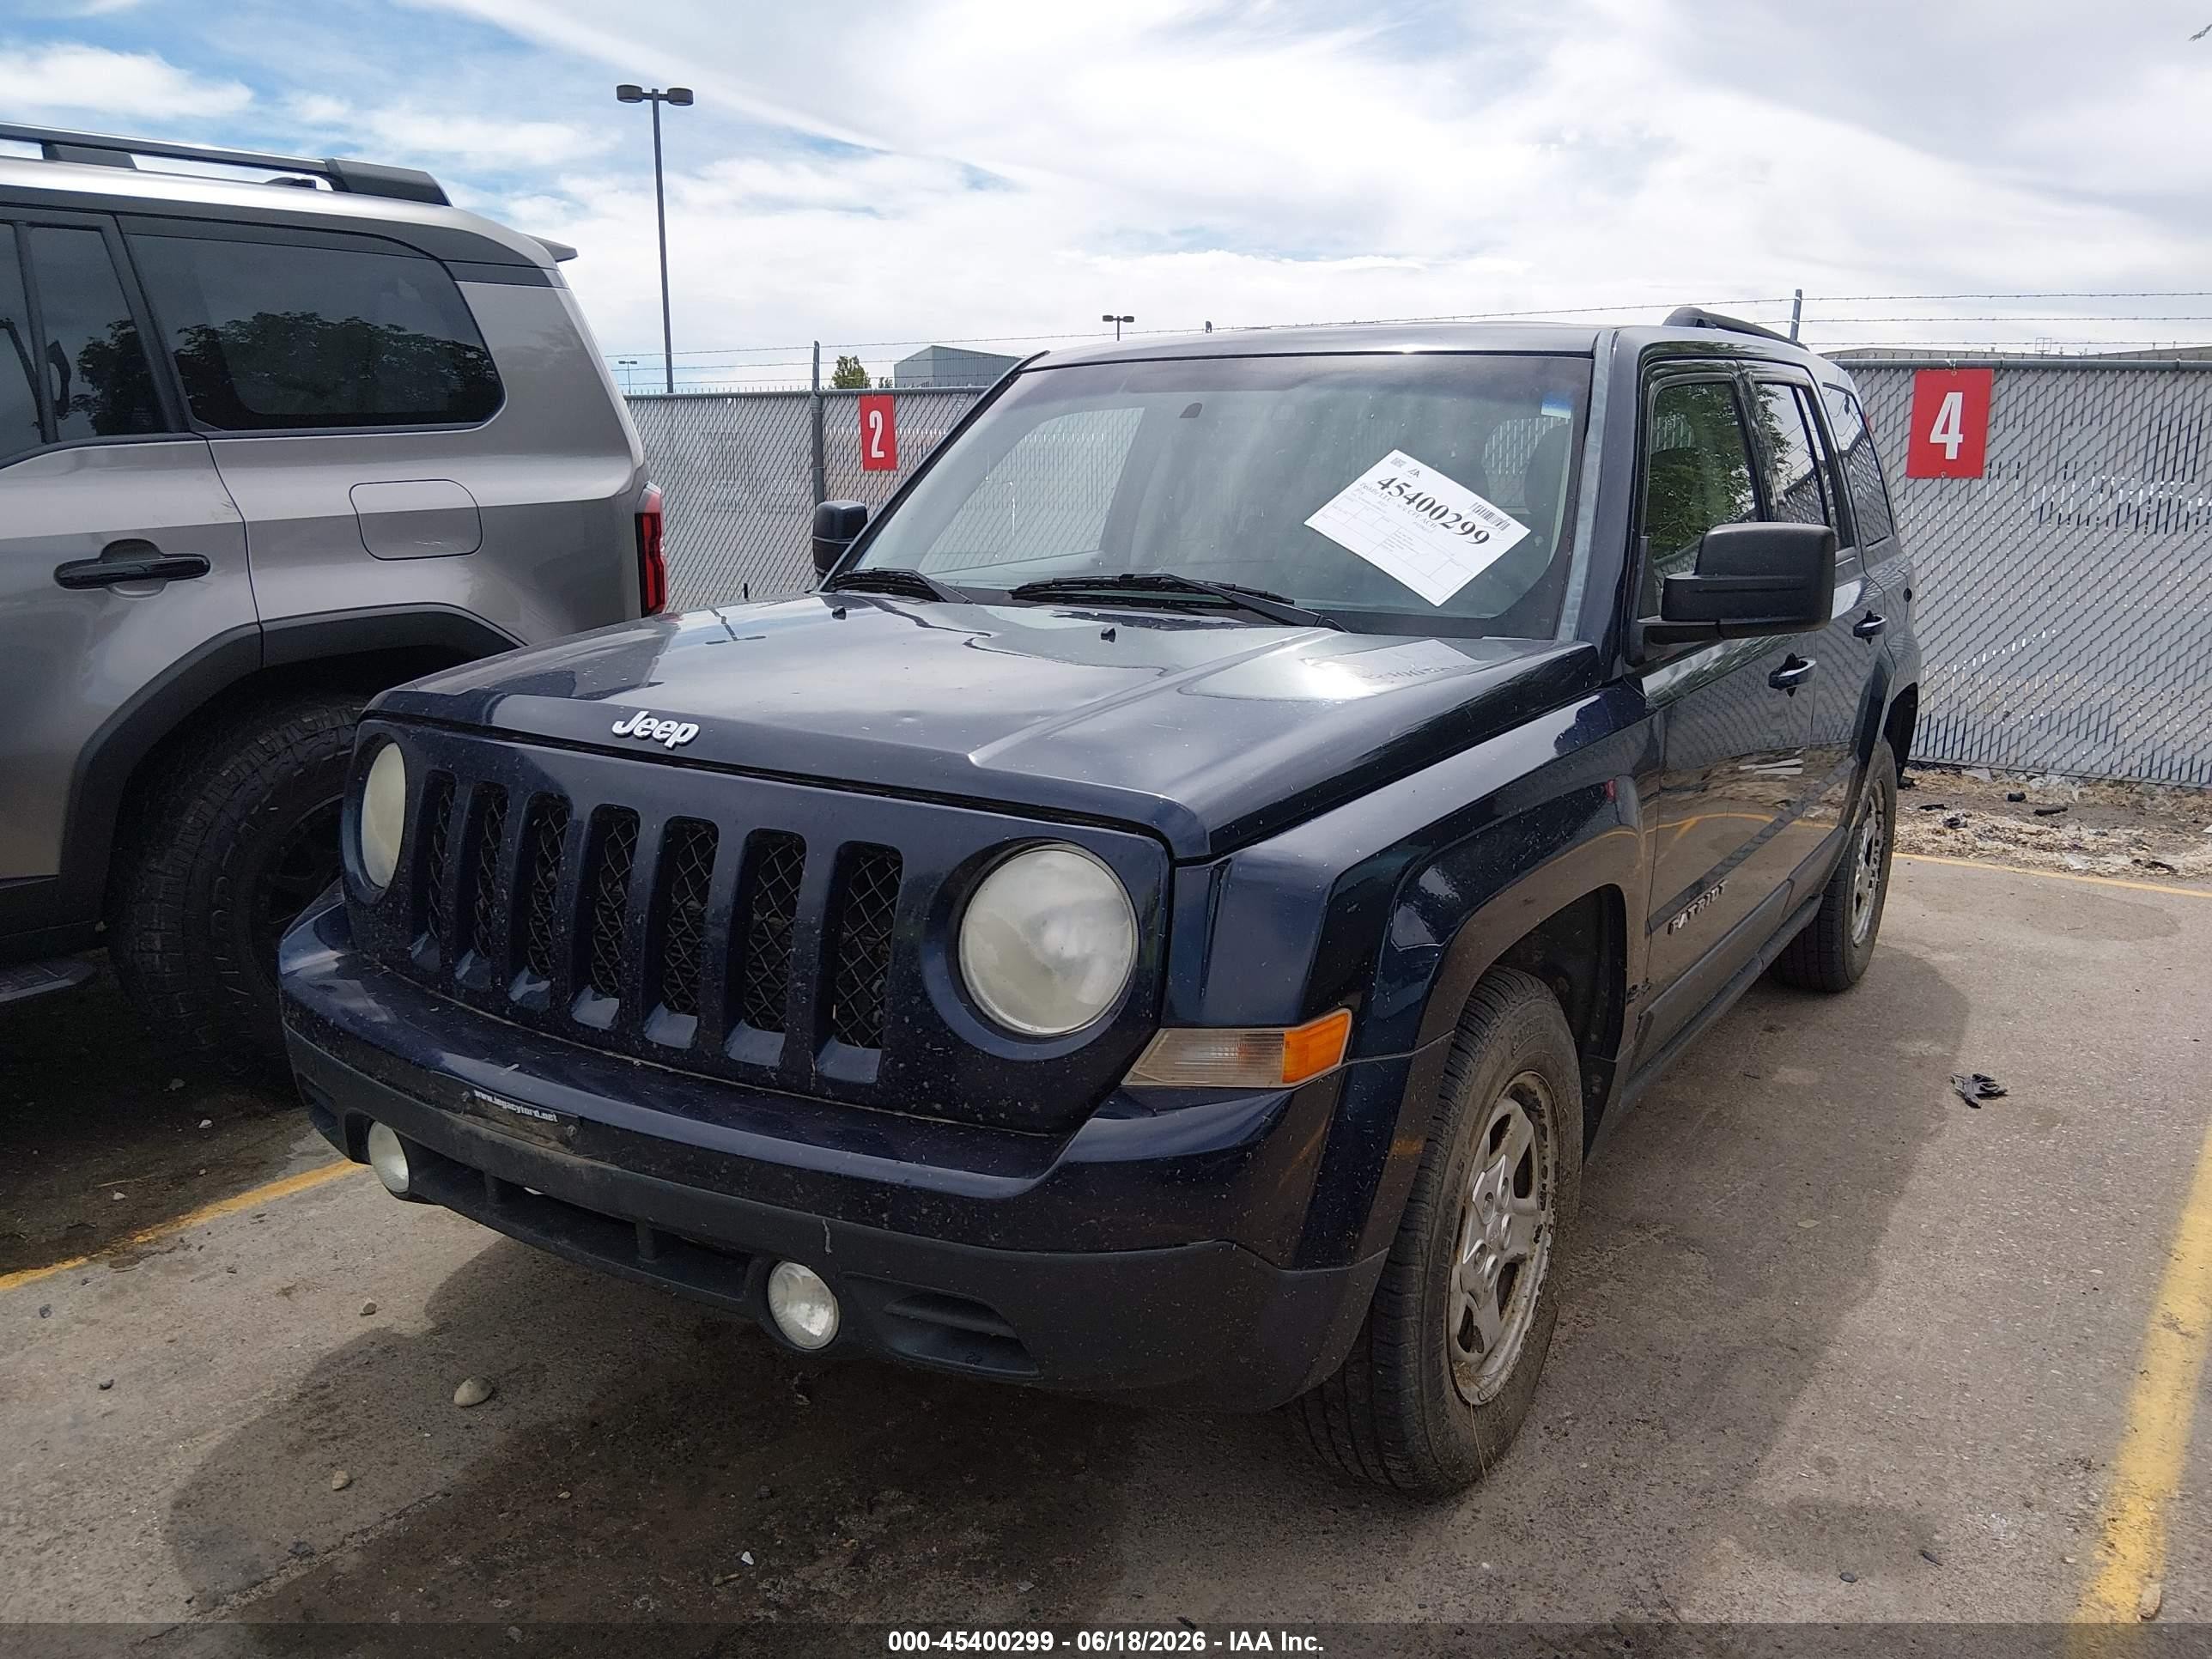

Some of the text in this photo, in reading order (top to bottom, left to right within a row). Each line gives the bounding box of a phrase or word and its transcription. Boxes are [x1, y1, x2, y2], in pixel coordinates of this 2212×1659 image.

[869, 410, 885, 459] 2
[1929, 392, 1964, 459] 4
[1376, 477, 1491, 544] 45400299
[611, 710, 700, 749] Jeep
[1668, 879, 1729, 934] PATRIOT
